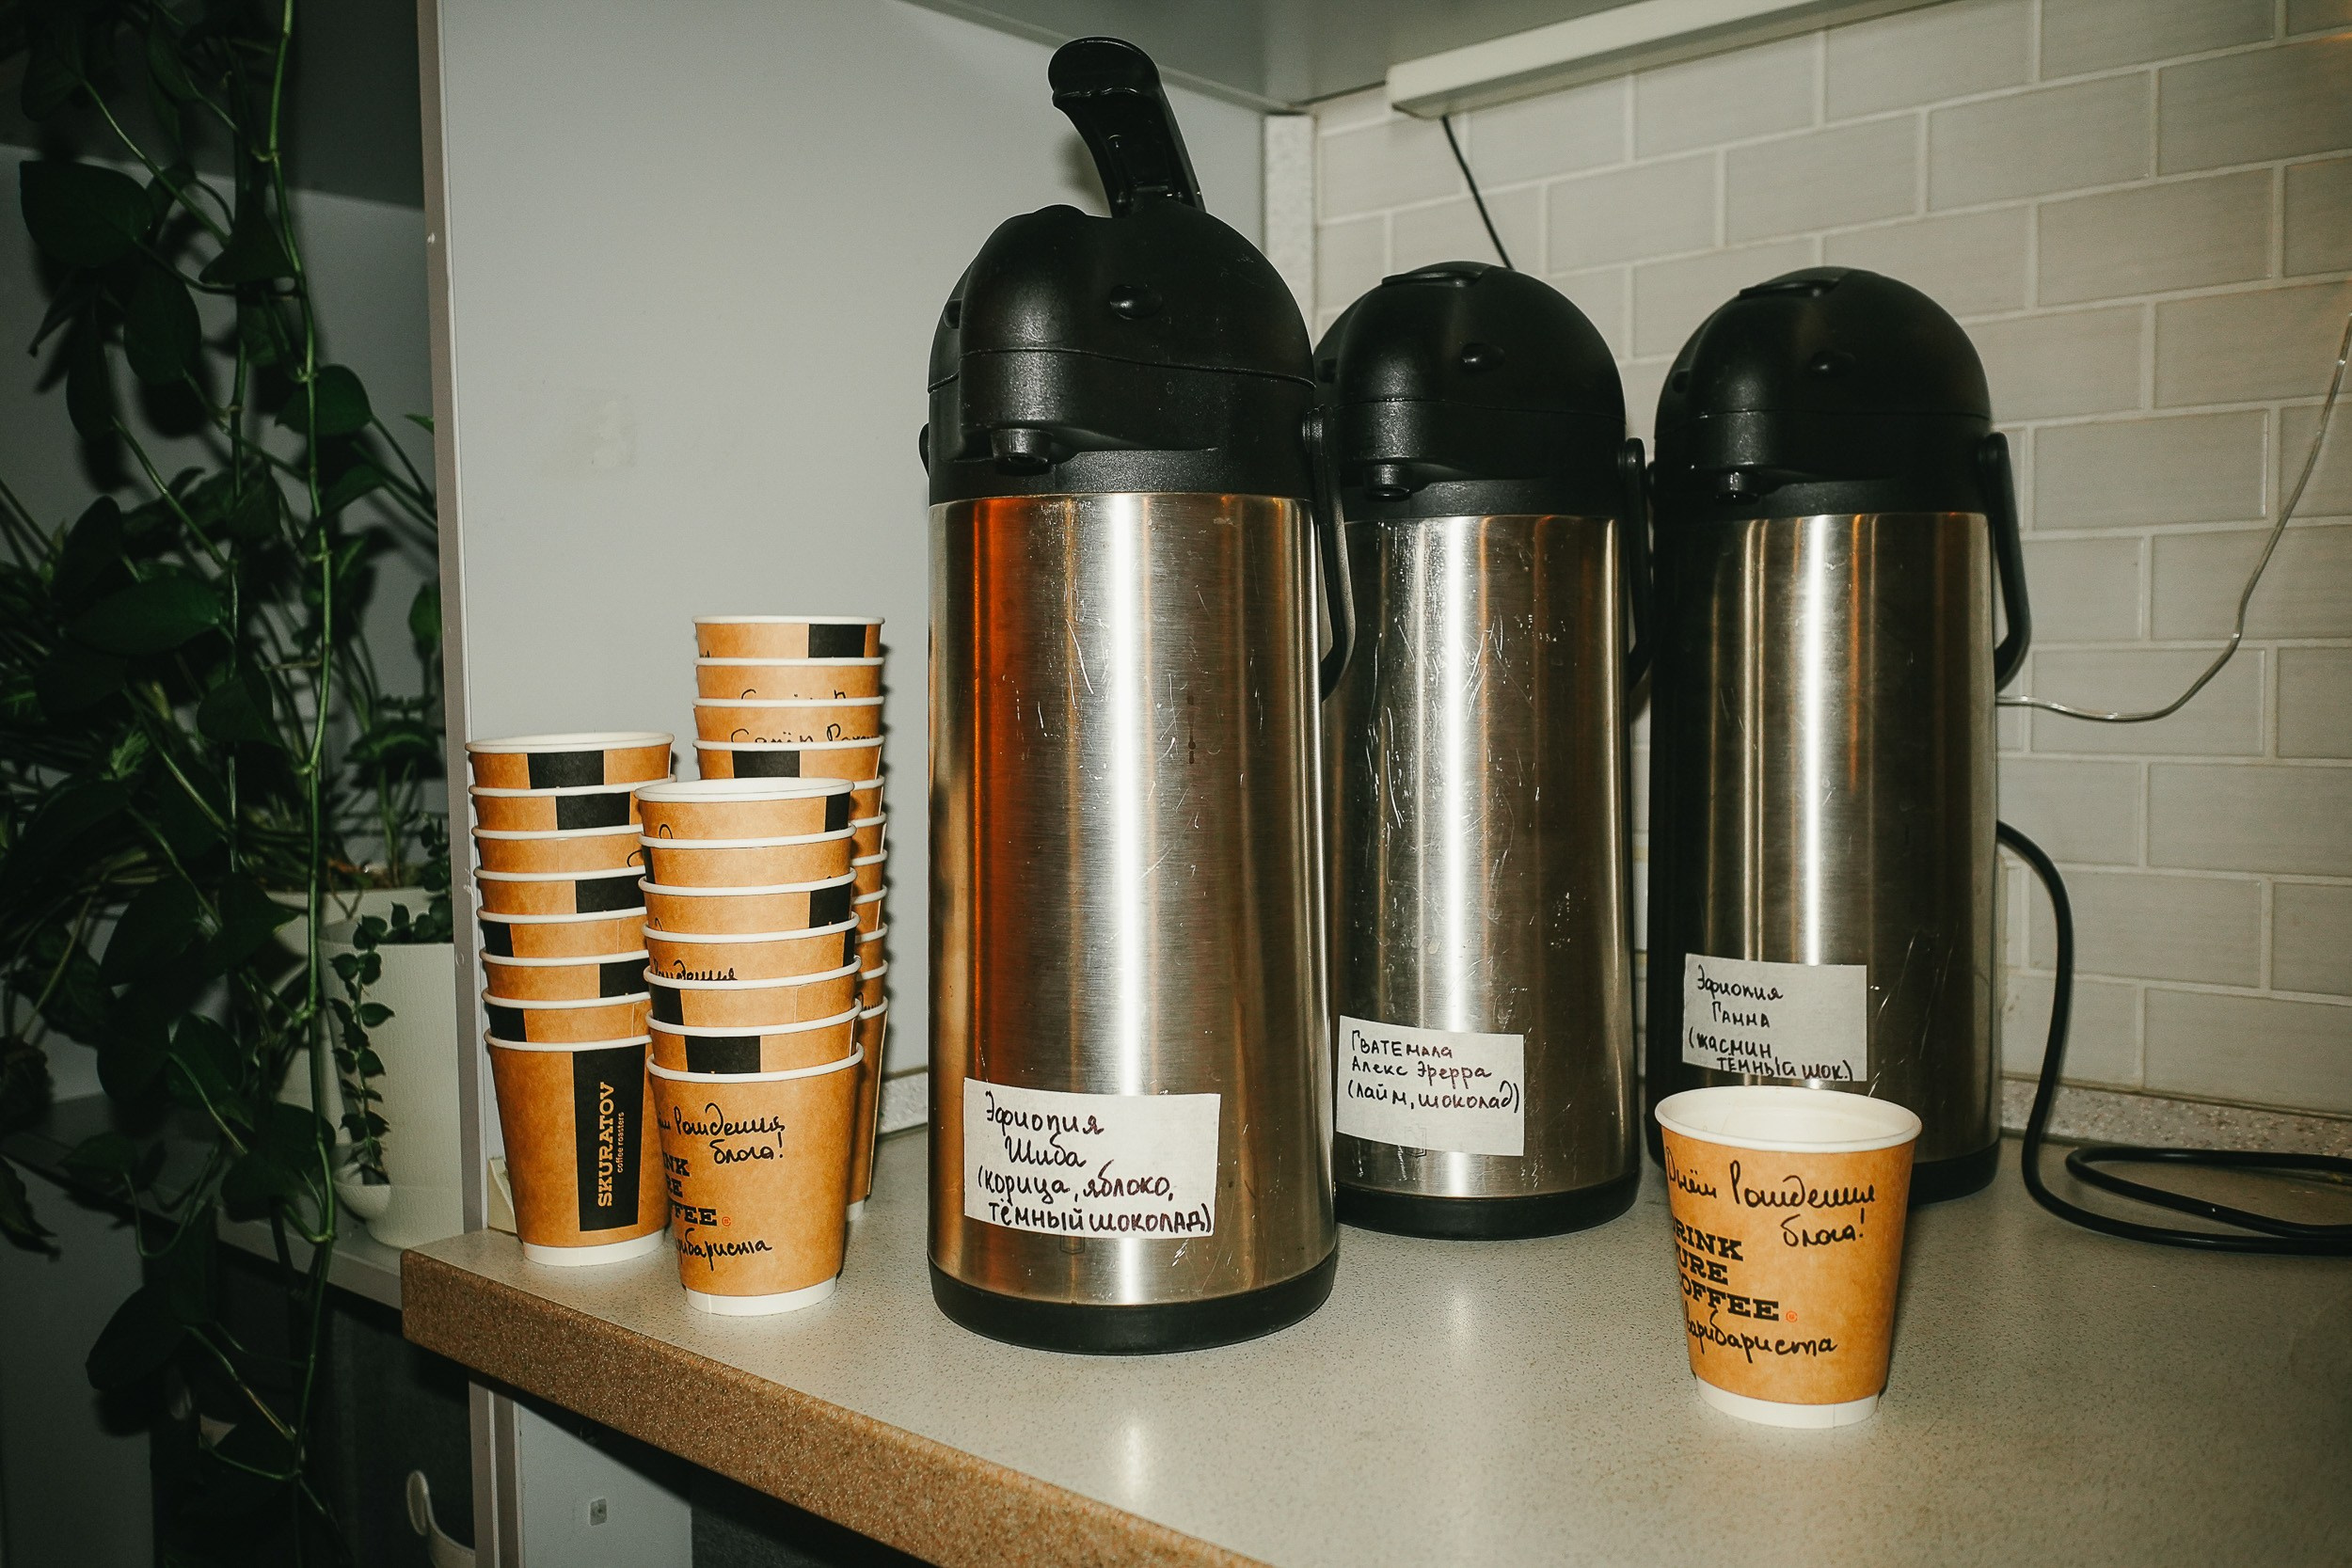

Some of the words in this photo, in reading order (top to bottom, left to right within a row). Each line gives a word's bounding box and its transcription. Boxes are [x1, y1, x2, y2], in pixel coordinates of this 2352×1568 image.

[1697, 964, 1784, 1000] Эфиопия
[1352, 1055, 1407, 1076] Алекс
[1417, 1060, 1492, 1089] Эрерра
[985, 1090, 1104, 1136] Эфиопия
[1347, 1079, 1415, 1110] (лайм,
[1418, 1080, 1519, 1114] шоколад)
[597, 1081, 614, 1207] SKURATOV
[617, 1112, 626, 1146] roasters
[615, 1147, 625, 1173] coffee
[1005, 1132, 1088, 1167] Шиба
[977, 1164, 1079, 1206] (корица,
[1083, 1159, 1174, 1201] яблоко,
[1673, 1216, 1744, 1262] RINK
[1676, 1243, 1729, 1286] URE
[1679, 1272, 1779, 1322] OFFEE
